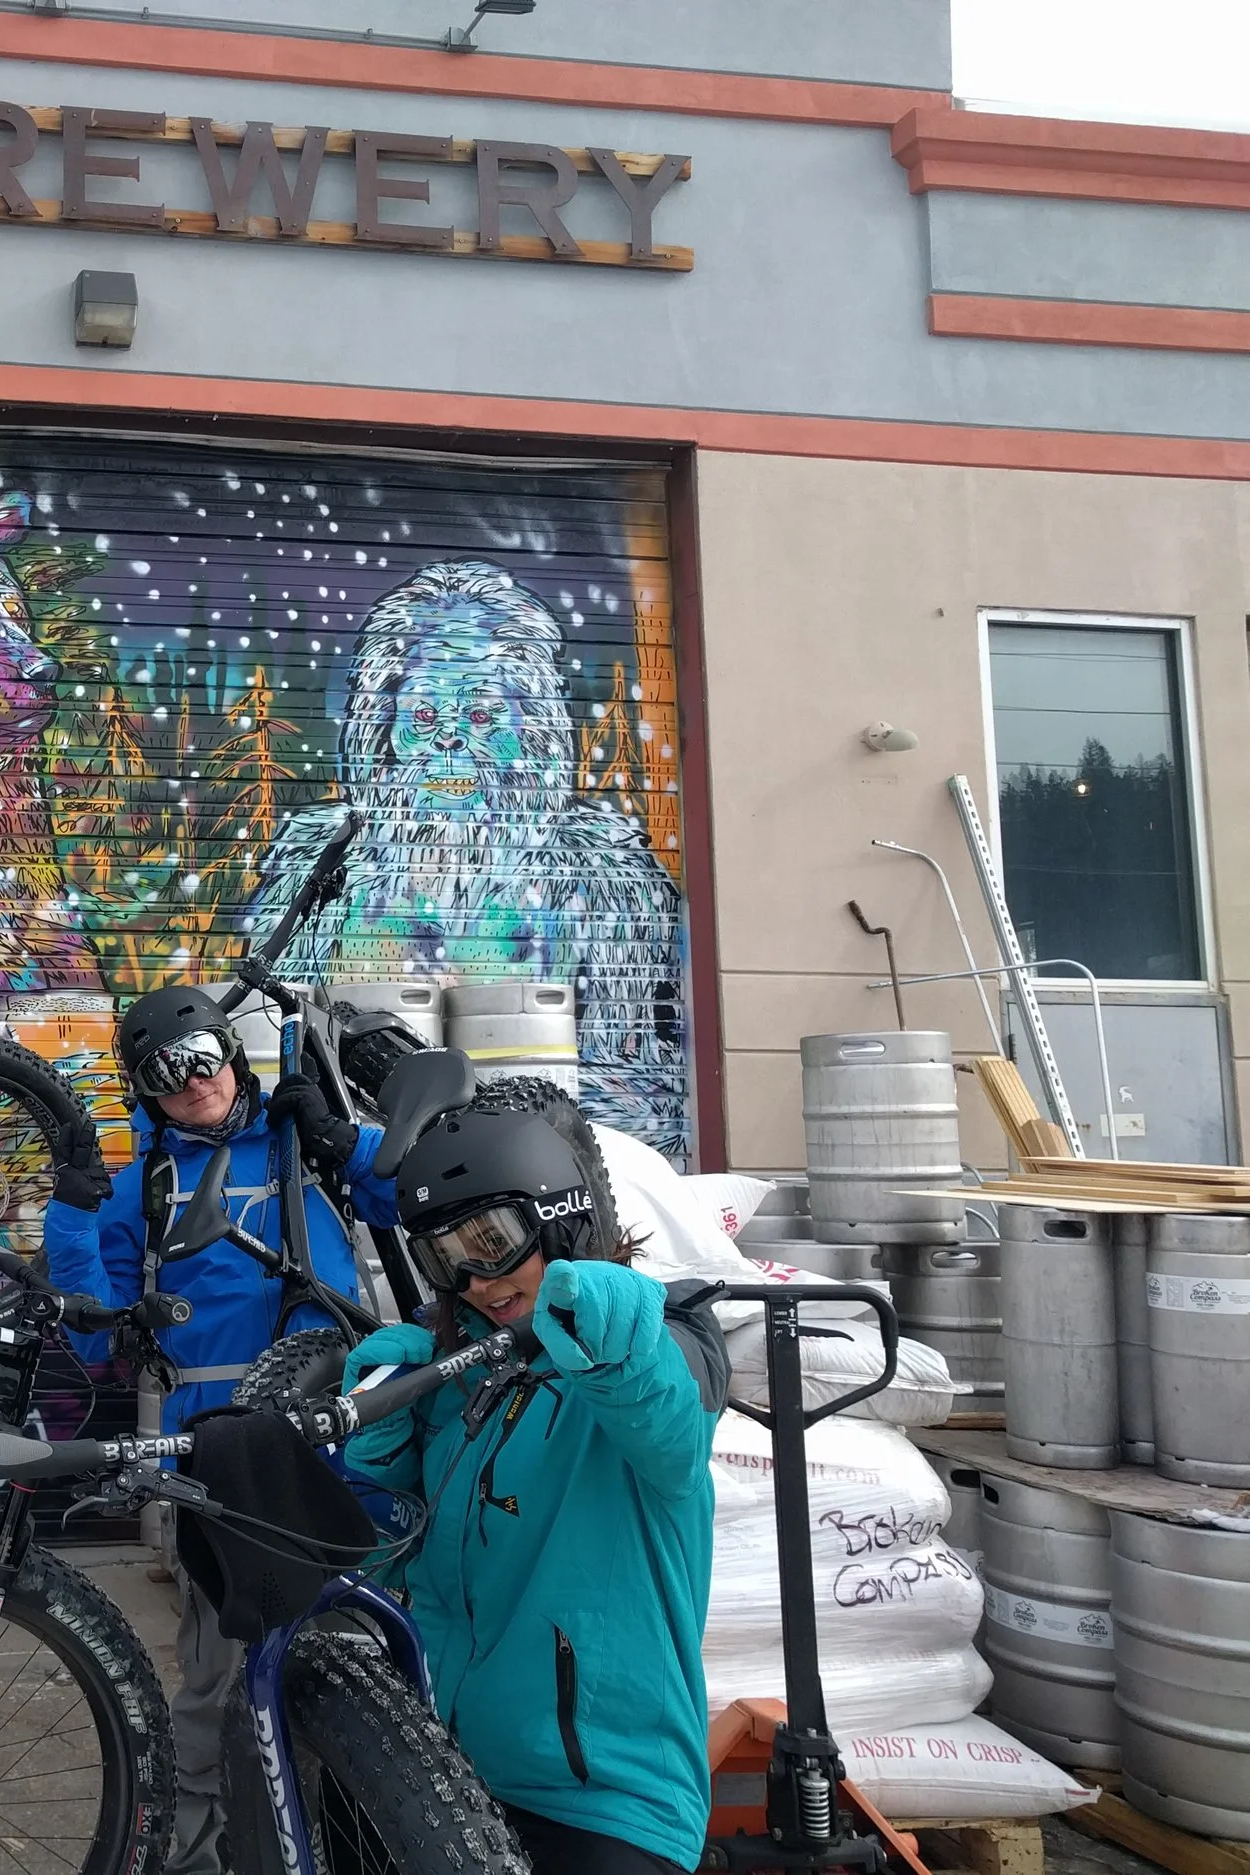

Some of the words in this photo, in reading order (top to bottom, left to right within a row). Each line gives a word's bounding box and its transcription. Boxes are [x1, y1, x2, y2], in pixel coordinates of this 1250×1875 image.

[534, 1190, 593, 1221] bollé
[46, 1602, 125, 1679] MINION
[852, 1735, 917, 1759] INSIST
[927, 1737, 959, 1760] ON
[966, 1741, 1023, 1764] CRISP
